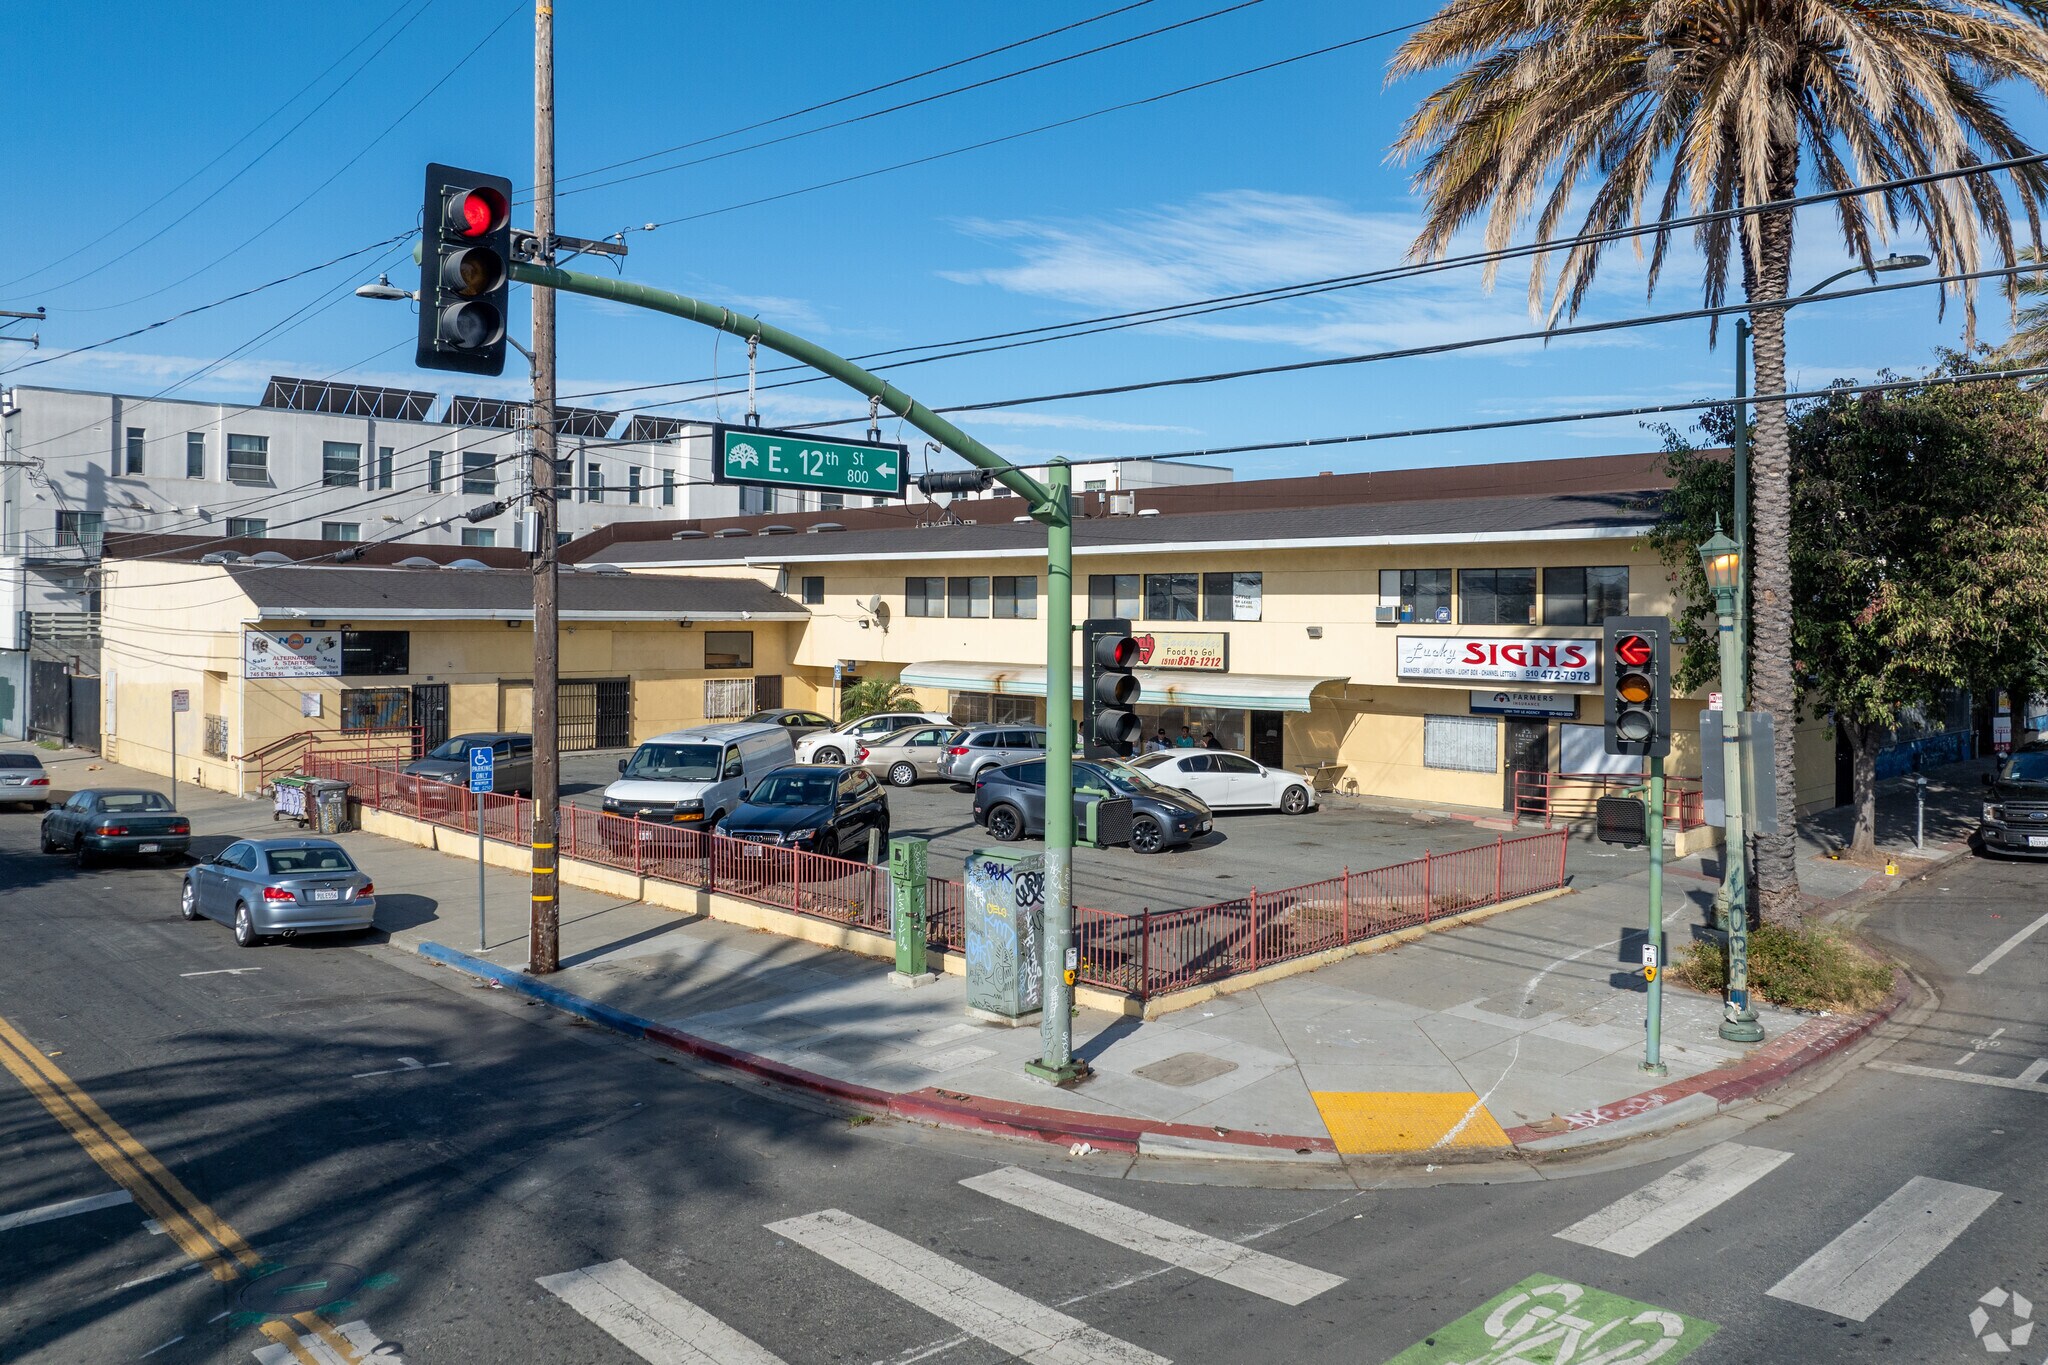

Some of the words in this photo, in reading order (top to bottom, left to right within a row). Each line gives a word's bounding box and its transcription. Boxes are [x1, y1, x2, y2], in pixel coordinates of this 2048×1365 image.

[768, 445, 789, 474] E.
[799, 449, 839, 477] 12th
[852, 451, 864, 466] St
[847, 469, 869, 484] 800
[1166, 648, 1187, 656] Food
[1190, 648, 1199, 656] to
[1201, 648, 1215, 656] Go!
[1406, 643, 1457, 664] Lucky
[1461, 642, 1588, 668] SIGNS
[1481, 669, 1499, 677] CHANNEL
[1500, 670, 1517, 678] LETTERS
[1525, 669, 1539, 679] 510
[1540, 669, 1591, 681] 472-7978
[1513, 693, 1554, 702] FARMERS
